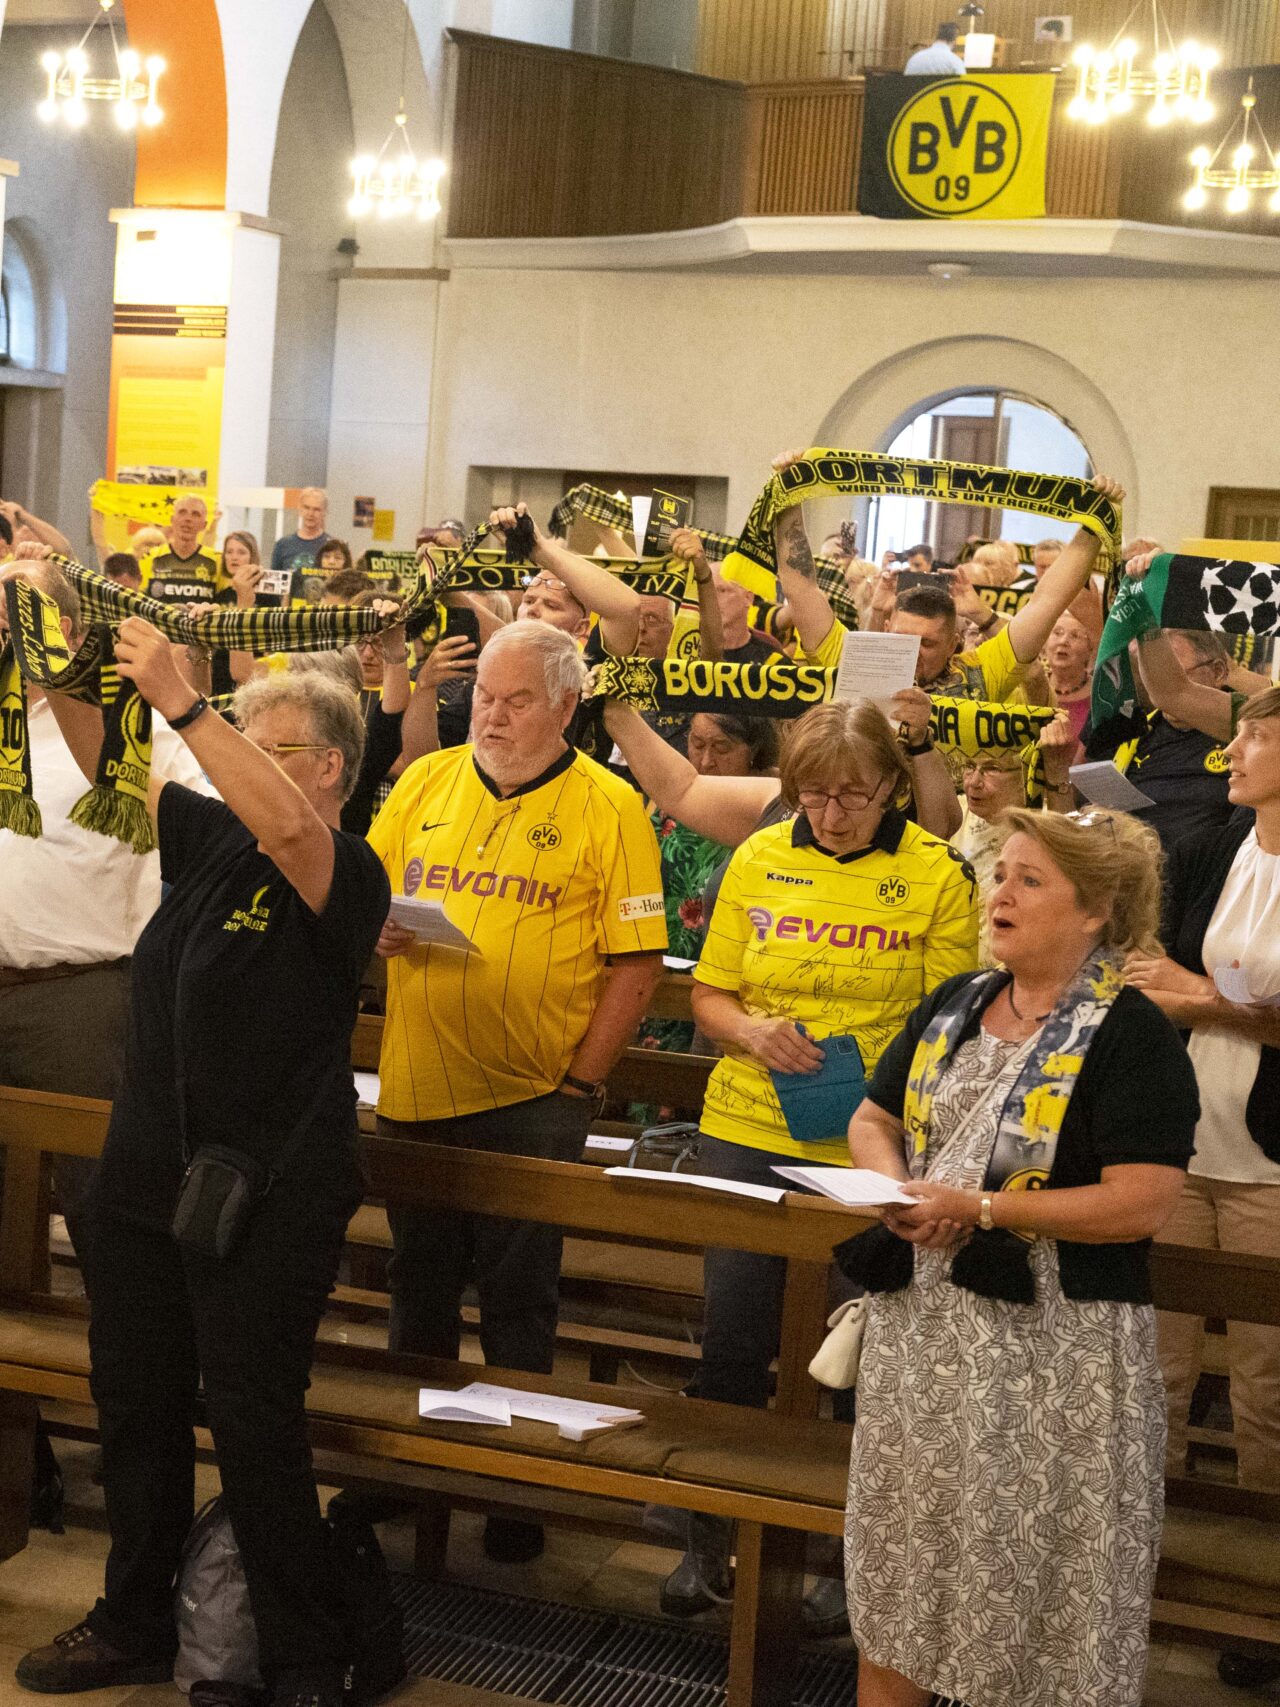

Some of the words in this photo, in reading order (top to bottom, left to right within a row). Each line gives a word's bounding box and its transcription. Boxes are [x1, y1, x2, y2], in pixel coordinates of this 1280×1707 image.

[908, 95, 1007, 175] BVB
[935, 175, 970, 201] 09
[778, 458, 1119, 534] DORTMUND
[837, 484, 881, 494] WIRD
[885, 485, 959, 501] NIEMALS
[963, 491, 1074, 520] UNTERGEHEN!
[531, 826, 559, 847] BVB
[425, 864, 563, 909] EVONIK
[766, 872, 814, 887] Kappa
[879, 878, 907, 899] BVB
[885, 896, 896, 904] 09
